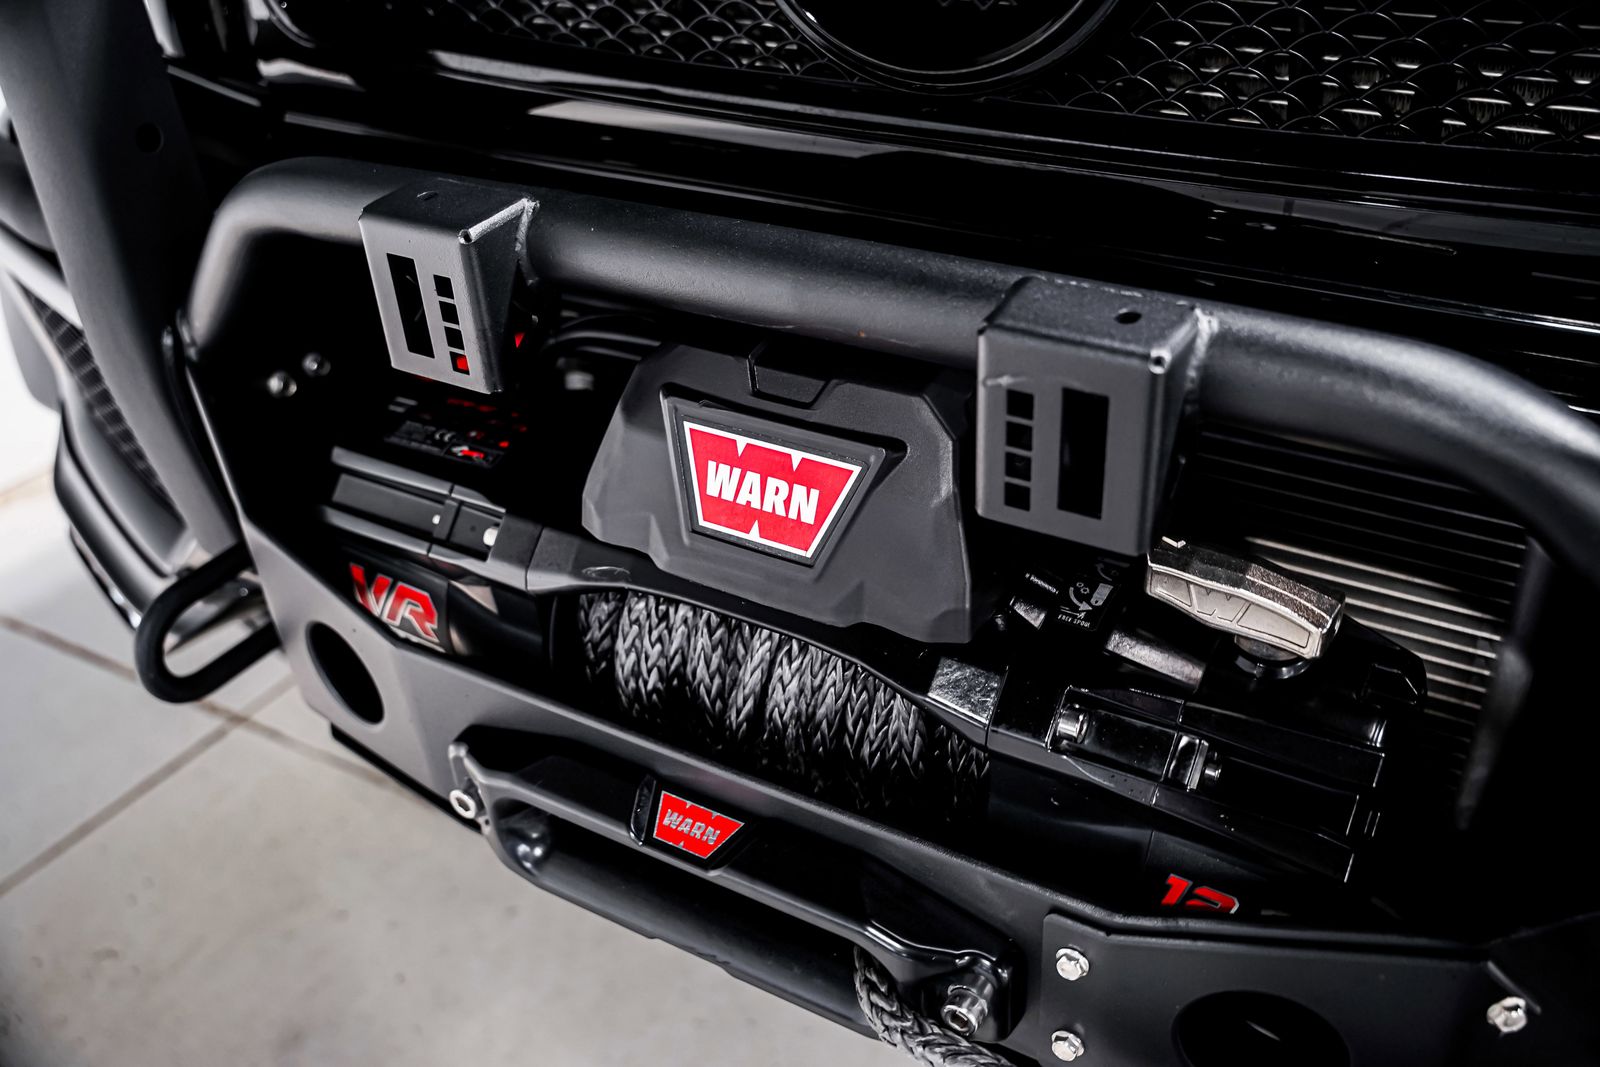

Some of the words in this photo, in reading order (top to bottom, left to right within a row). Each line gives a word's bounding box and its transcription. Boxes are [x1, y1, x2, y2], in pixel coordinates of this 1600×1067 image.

[706, 460, 820, 525] WARN
[348, 562, 440, 643] VR
[662, 808, 721, 845] WARN
